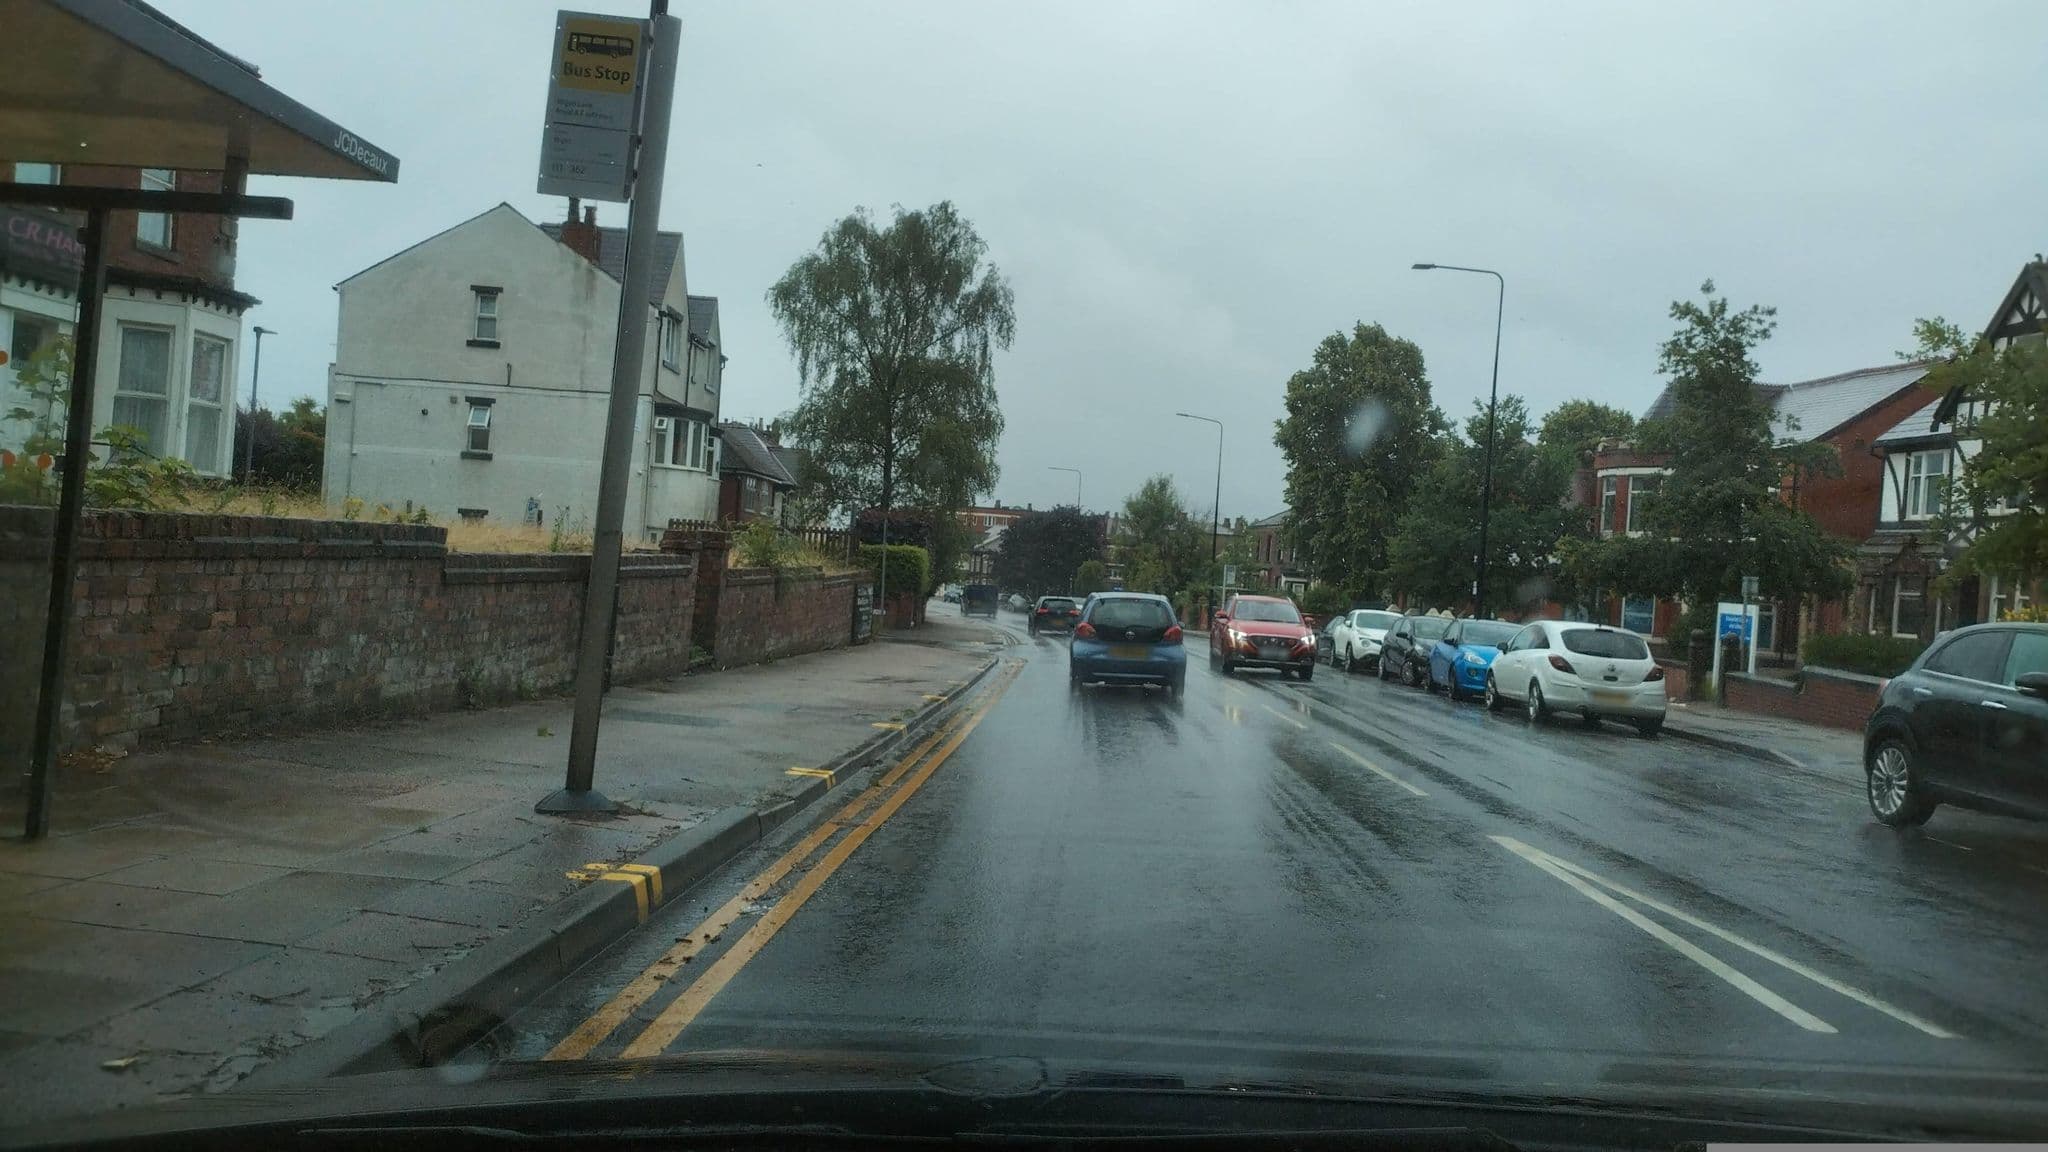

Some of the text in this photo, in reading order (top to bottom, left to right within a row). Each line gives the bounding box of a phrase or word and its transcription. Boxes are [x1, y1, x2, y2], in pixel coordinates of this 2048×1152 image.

[564, 61, 630, 84] Bus Stop
[335, 131, 387, 173] JCDecaux
